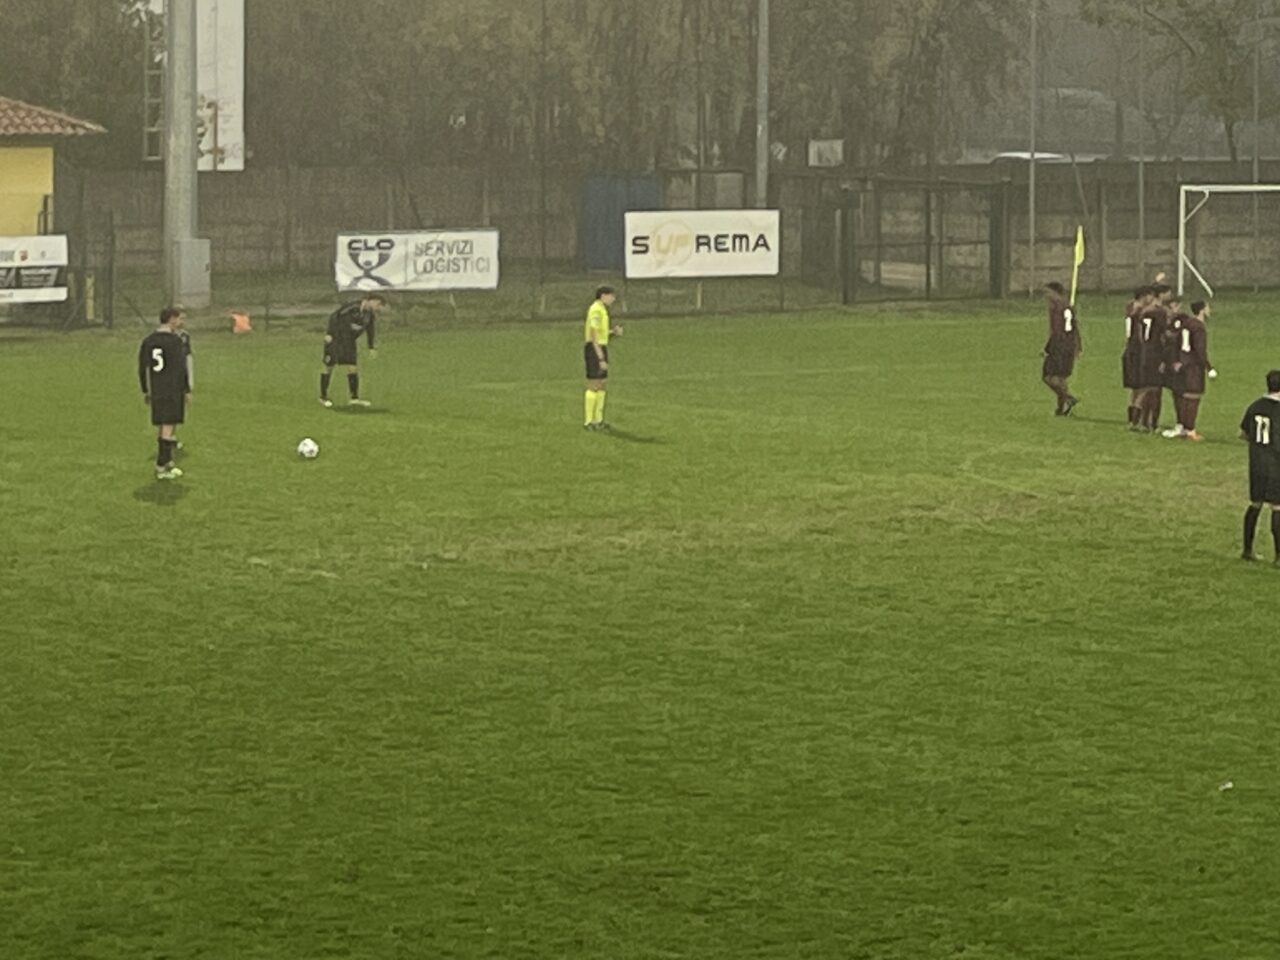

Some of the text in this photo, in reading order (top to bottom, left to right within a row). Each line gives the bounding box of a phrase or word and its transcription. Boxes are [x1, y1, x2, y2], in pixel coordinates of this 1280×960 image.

[347, 239, 395, 252] CLO
[414, 240, 474, 257] SERVIZI
[631, 233, 771, 255] SUPREMA
[413, 256, 491, 276] LOGISTICI
[152, 348, 164, 372] 5
[1254, 414, 1271, 445] 11
